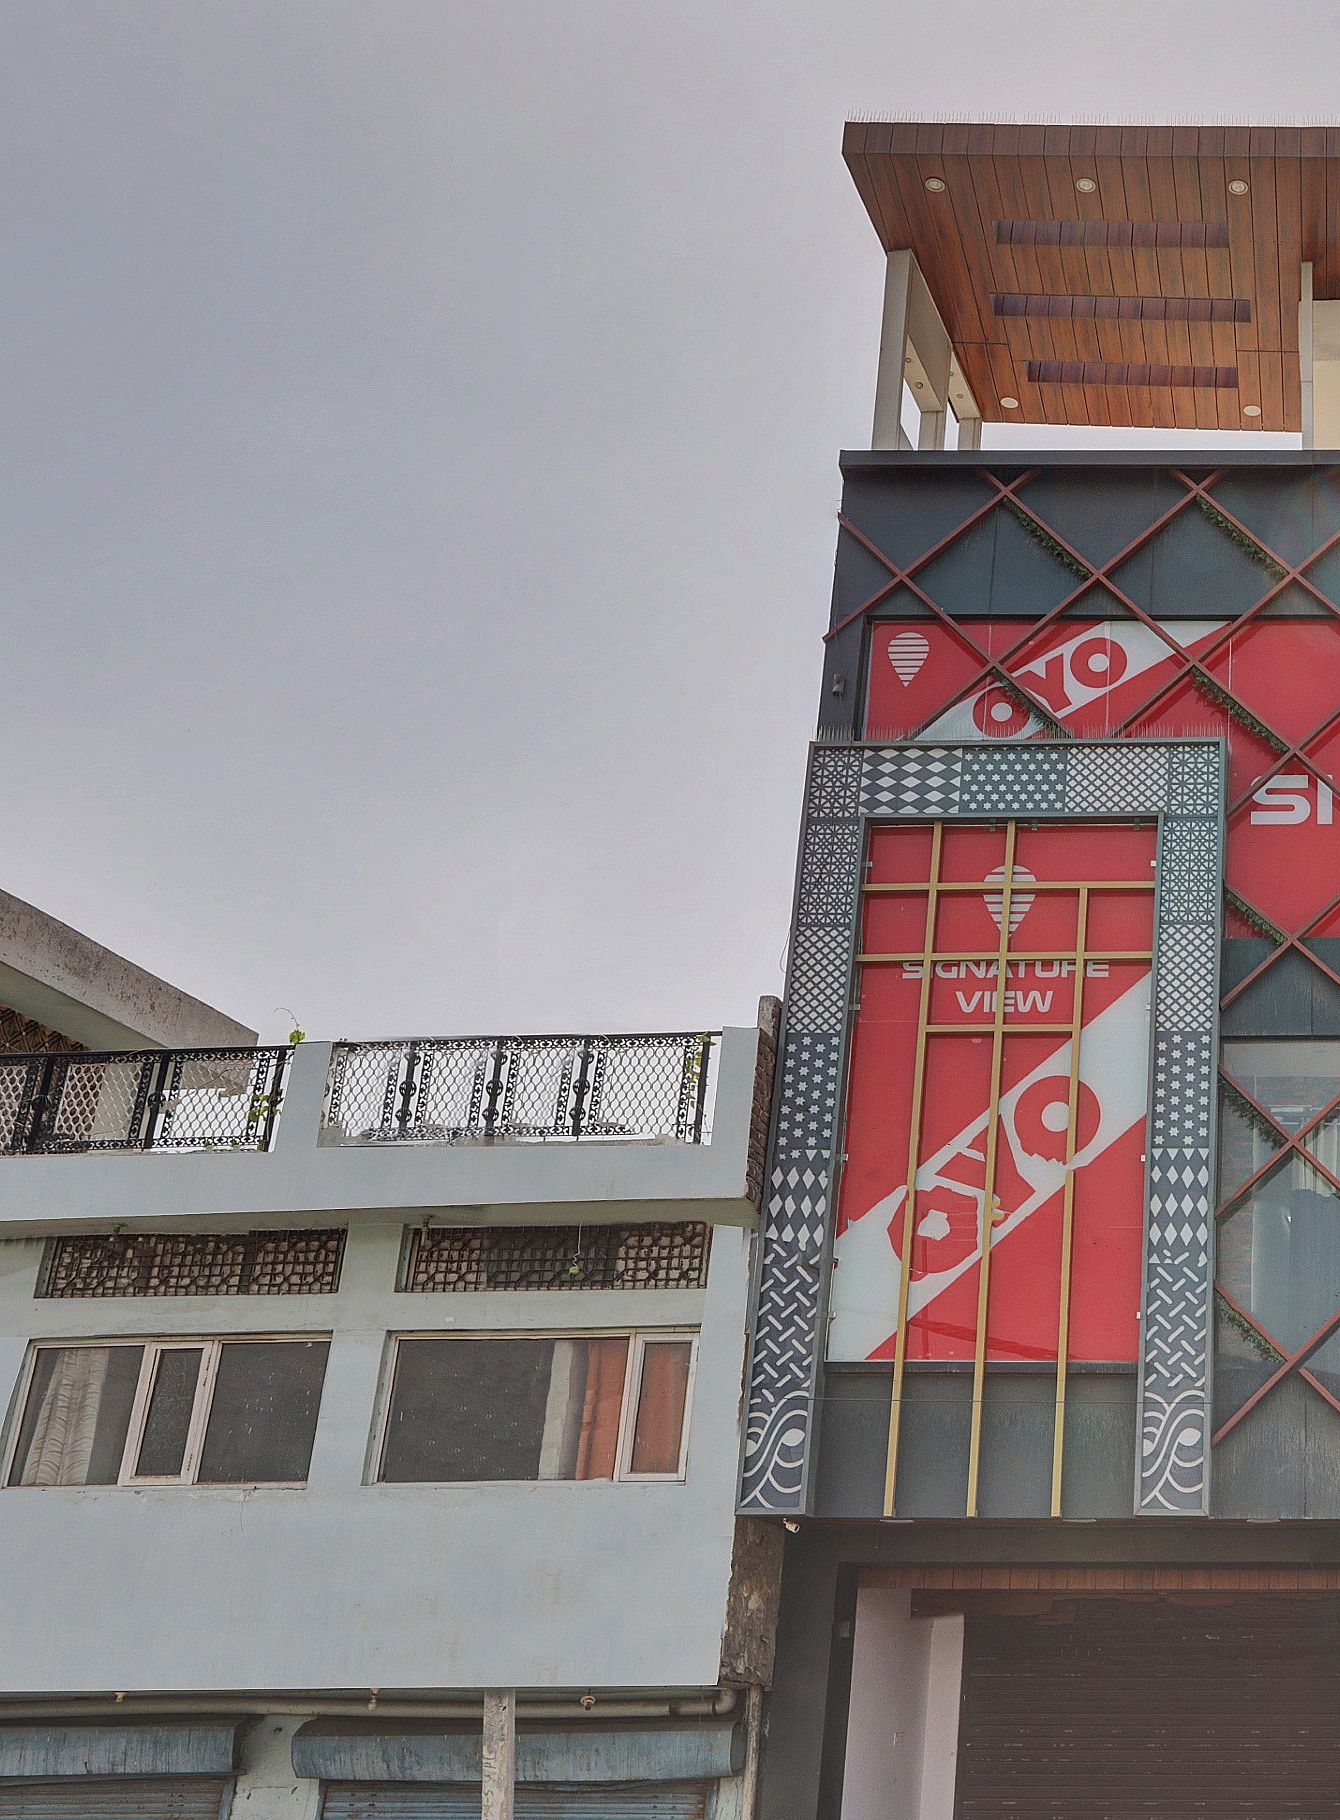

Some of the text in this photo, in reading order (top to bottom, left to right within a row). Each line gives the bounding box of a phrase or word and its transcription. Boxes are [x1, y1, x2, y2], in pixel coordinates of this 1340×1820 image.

[973, 637, 1128, 739] OYO
[902, 960, 1109, 979] SGNATURE
[955, 990, 1054, 1013] VIEW
